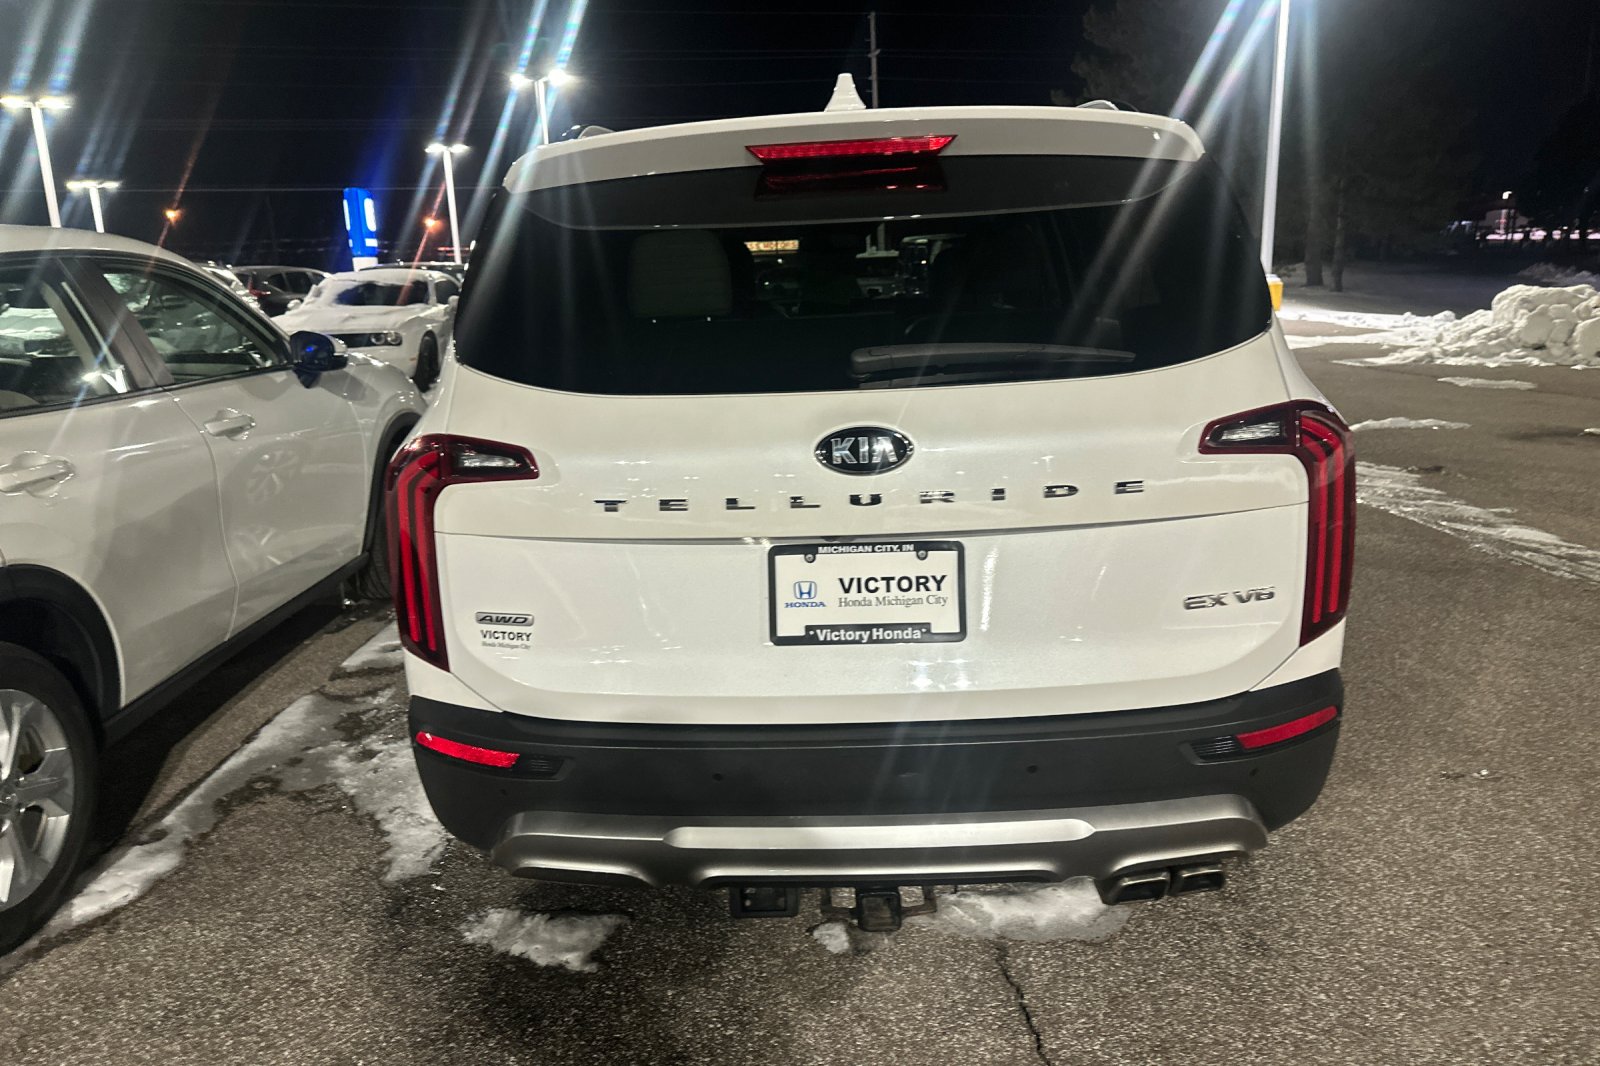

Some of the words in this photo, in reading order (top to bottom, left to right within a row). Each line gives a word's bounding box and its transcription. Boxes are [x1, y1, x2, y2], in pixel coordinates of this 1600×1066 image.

[830, 436, 898, 464] KIA
[594, 479, 1146, 513] TELLURIDE
[818, 545, 872, 554] MICHIGAN
[902, 544, 915, 552] IN
[838, 575, 947, 593] VICTORY
[838, 597, 872, 608] Honda
[875, 595, 923, 609] Michigan
[926, 594, 948, 607] City
[1184, 592, 1228, 610] EX
[1233, 586, 1275, 603] V6
[479, 615, 528, 624] AWD
[481, 630, 532, 641] VICTORY
[816, 629, 870, 643] Victory
[872, 628, 921, 640] Honda
